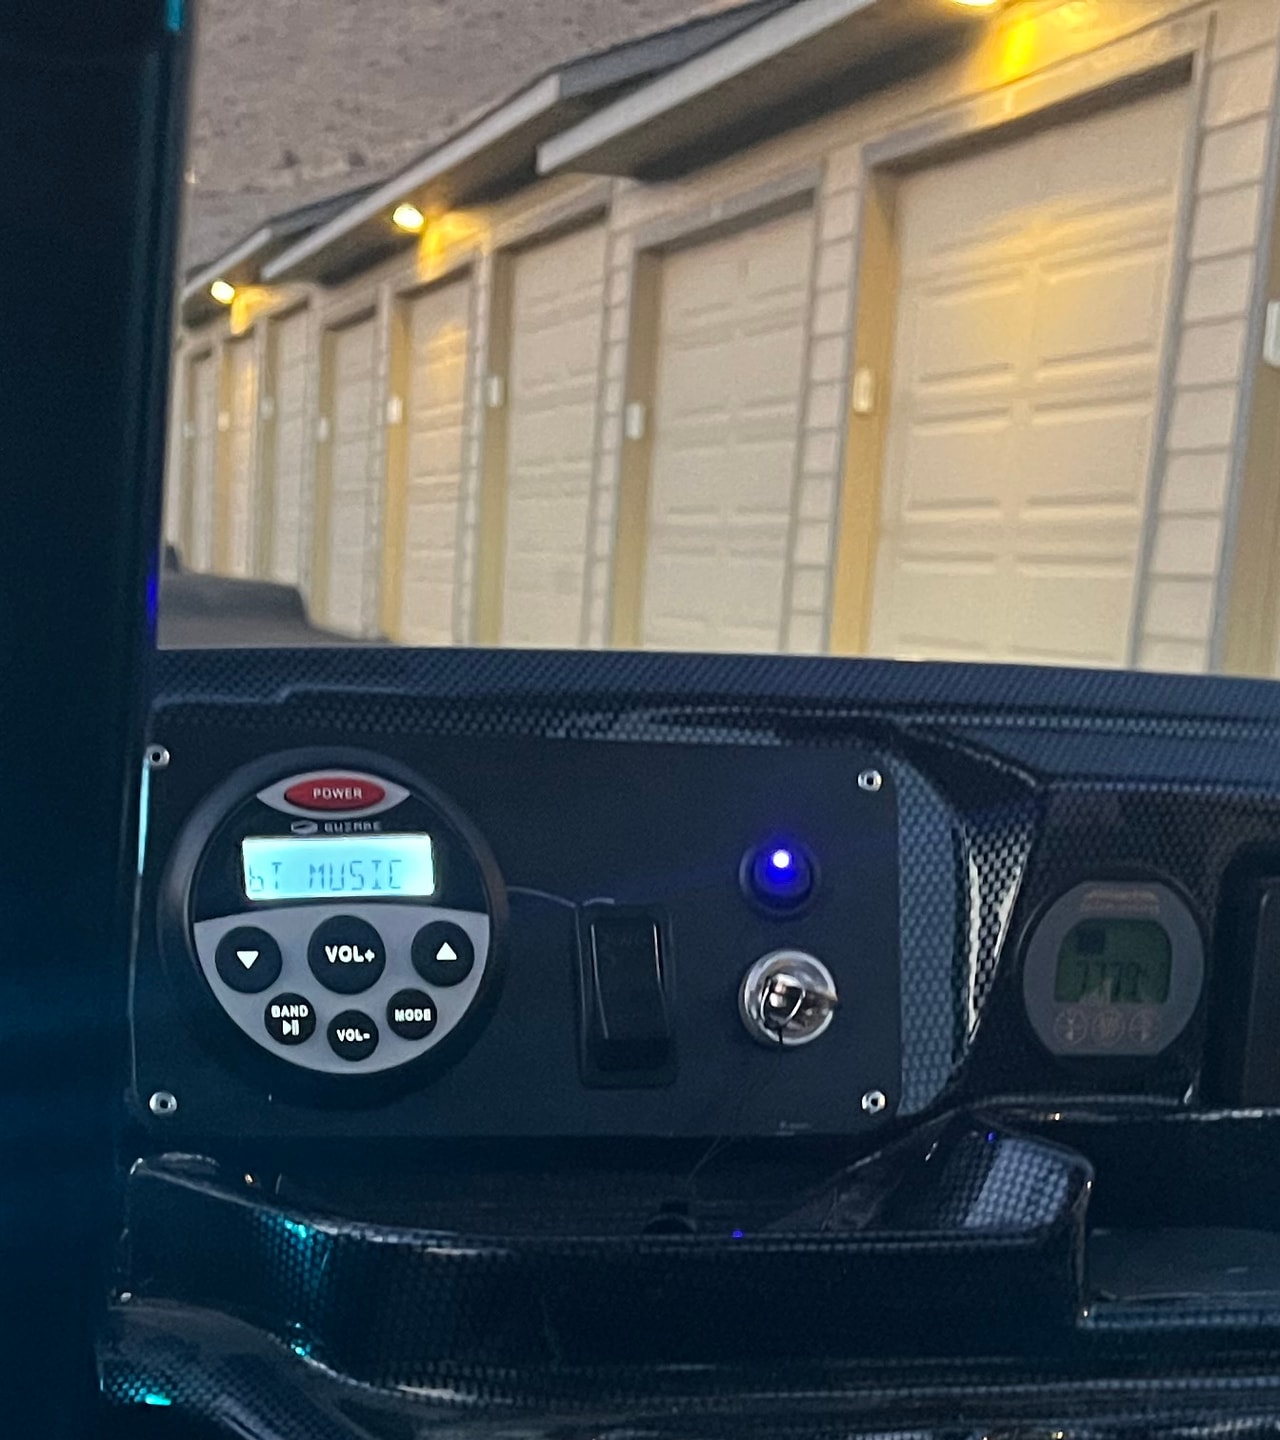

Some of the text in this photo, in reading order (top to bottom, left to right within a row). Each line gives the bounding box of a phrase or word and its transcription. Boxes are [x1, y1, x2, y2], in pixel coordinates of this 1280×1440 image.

[312, 787, 363, 799] POWER
[308, 859, 403, 891] MUSIC
[324, 944, 376, 964] VOL+
[270, 1004, 309, 1018] BAND
[394, 1008, 432, 1022] MODE
[335, 1028, 371, 1043] VOL-
